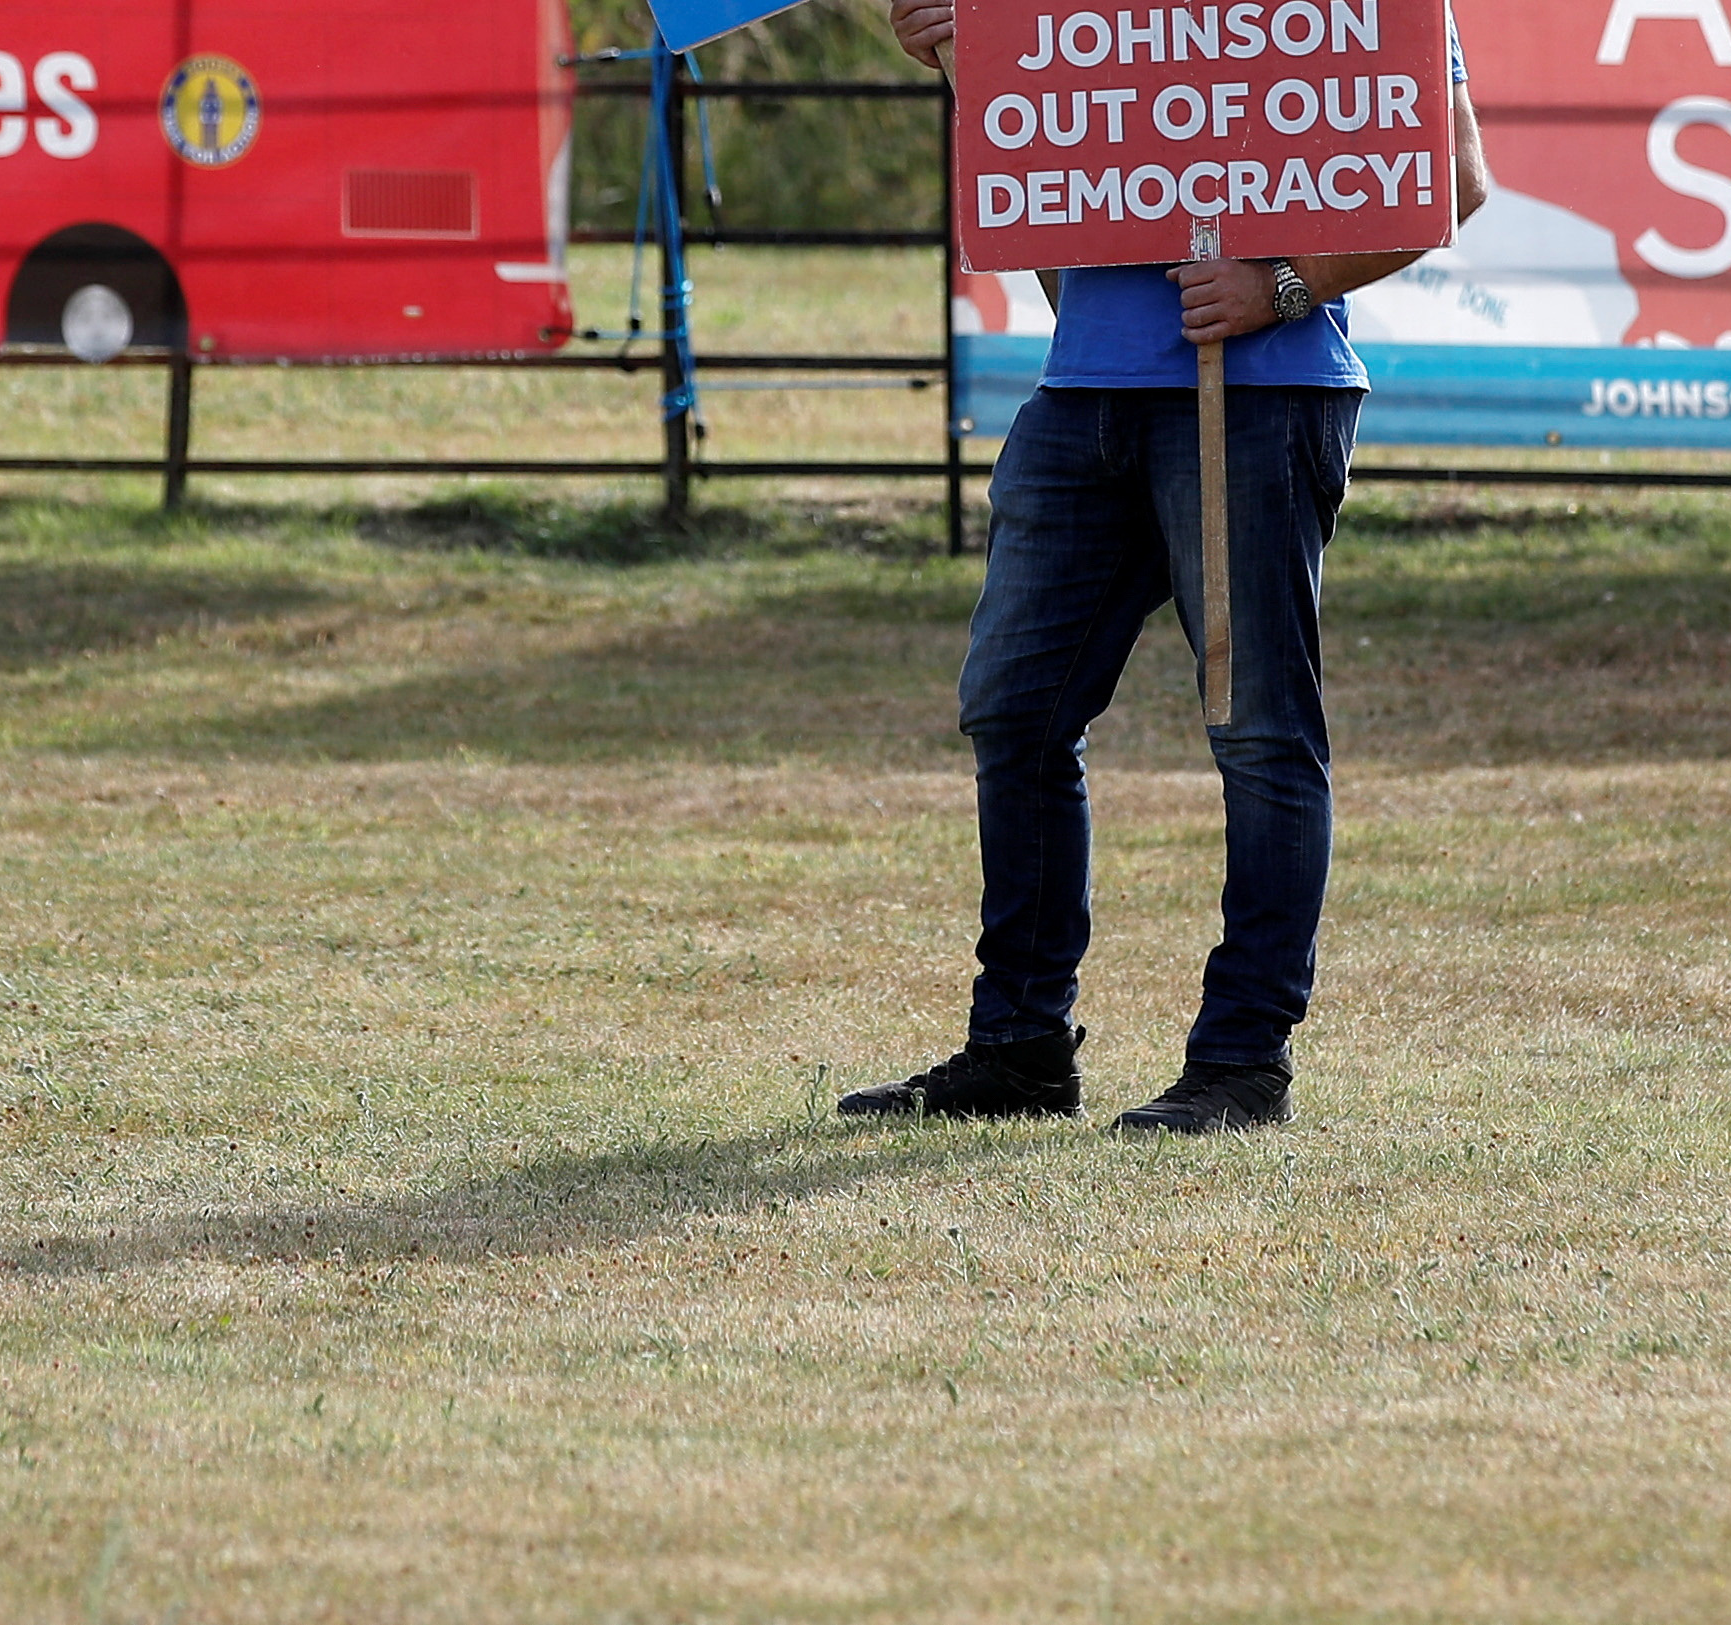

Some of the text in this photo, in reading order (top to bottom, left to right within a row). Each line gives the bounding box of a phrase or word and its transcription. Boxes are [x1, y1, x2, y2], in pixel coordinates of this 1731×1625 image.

[983, 74, 1422, 150] OUT OF OUR
[977, 151, 1432, 228] DEMOCRACY!
